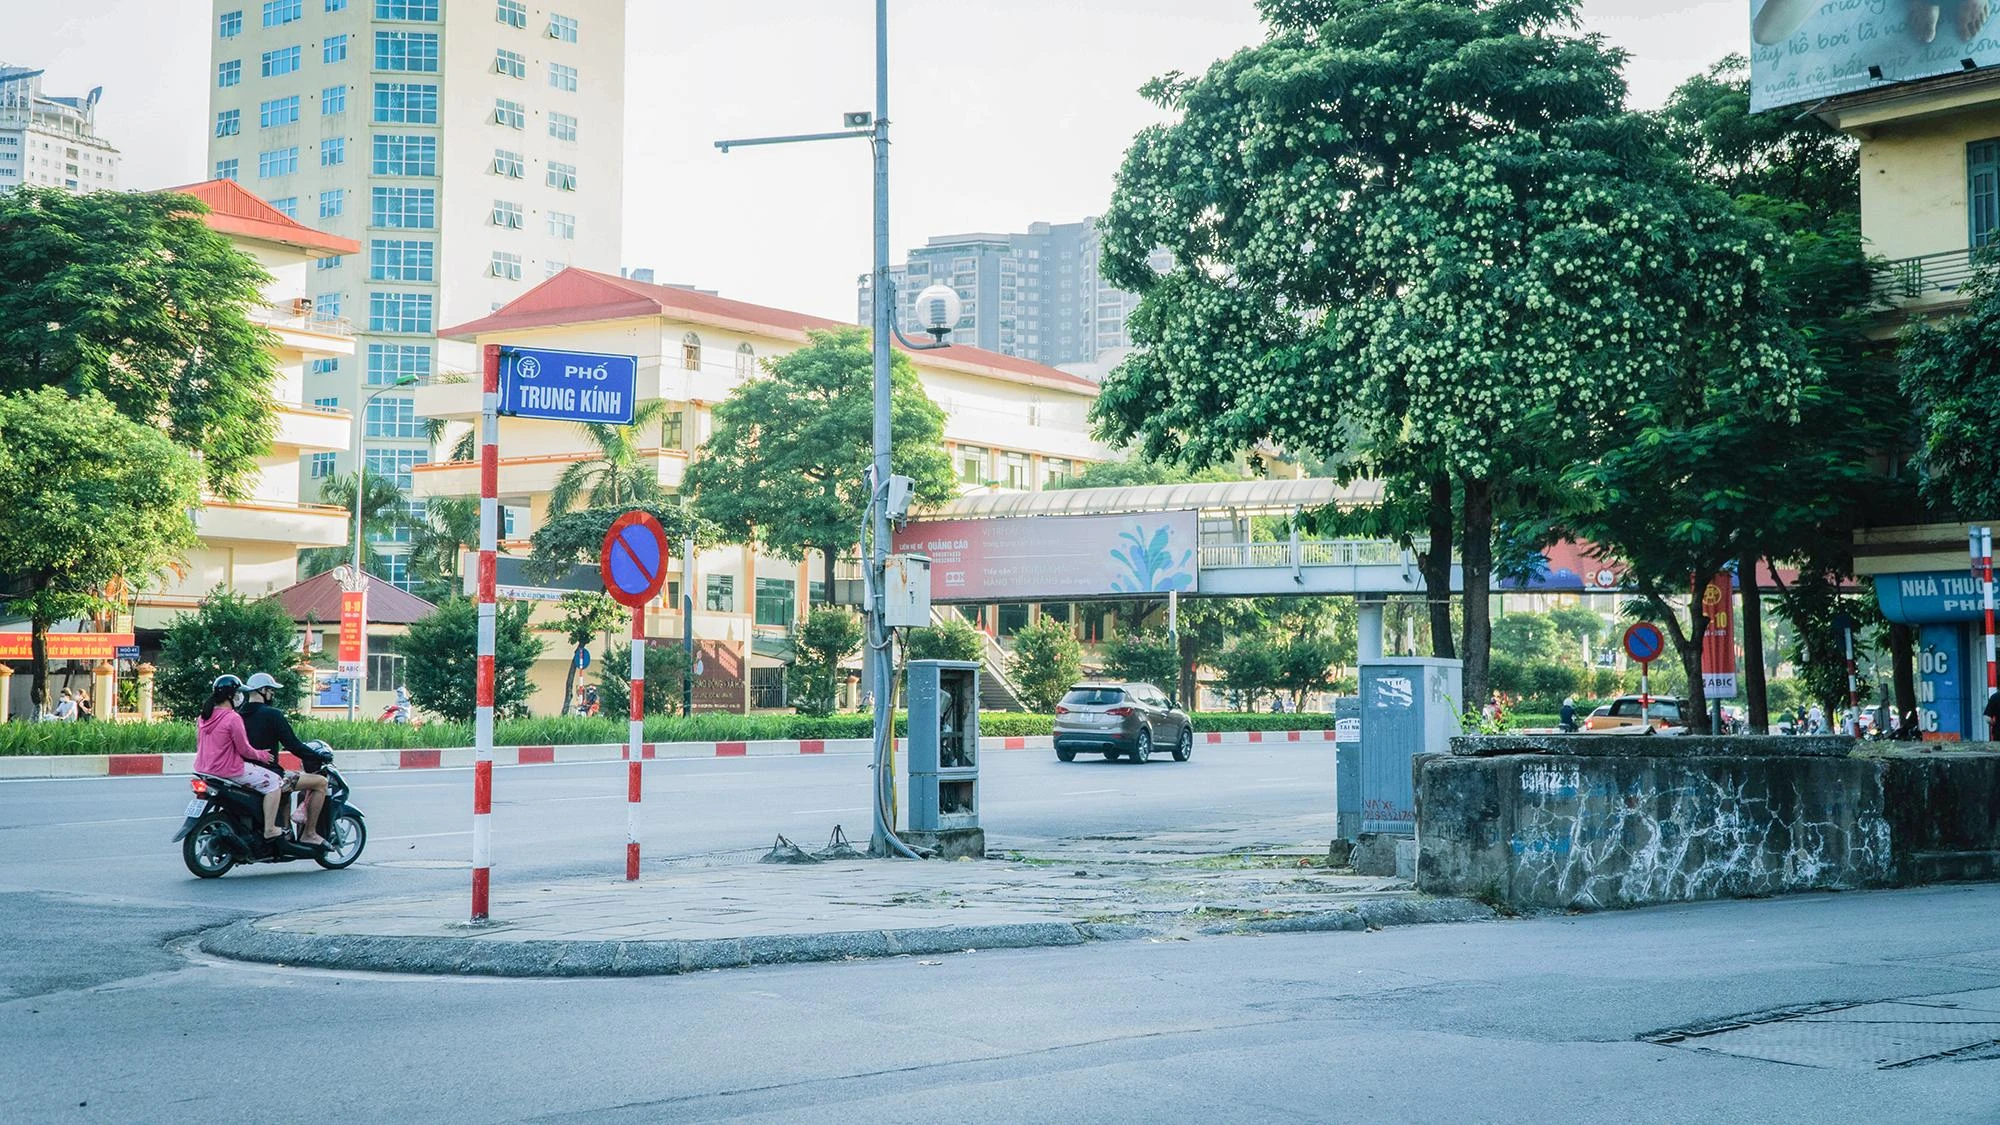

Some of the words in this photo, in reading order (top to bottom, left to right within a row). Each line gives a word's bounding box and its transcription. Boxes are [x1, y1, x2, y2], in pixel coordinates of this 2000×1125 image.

[1789, 31, 1809, 56] hồ
[1818, 28, 1850, 49] bơi
[565, 362, 608, 381] PHỐ
[520, 385, 575, 411] TRUNG
[580, 386, 621, 415] KÍNH
[927, 539, 952, 551] QUẢNG
[953, 540, 968, 550] CÁO
[1901, 576, 1938, 597] NHÀ
[8, 645, 19, 655] PHỐ
[1707, 678, 1733, 687] ABIC
